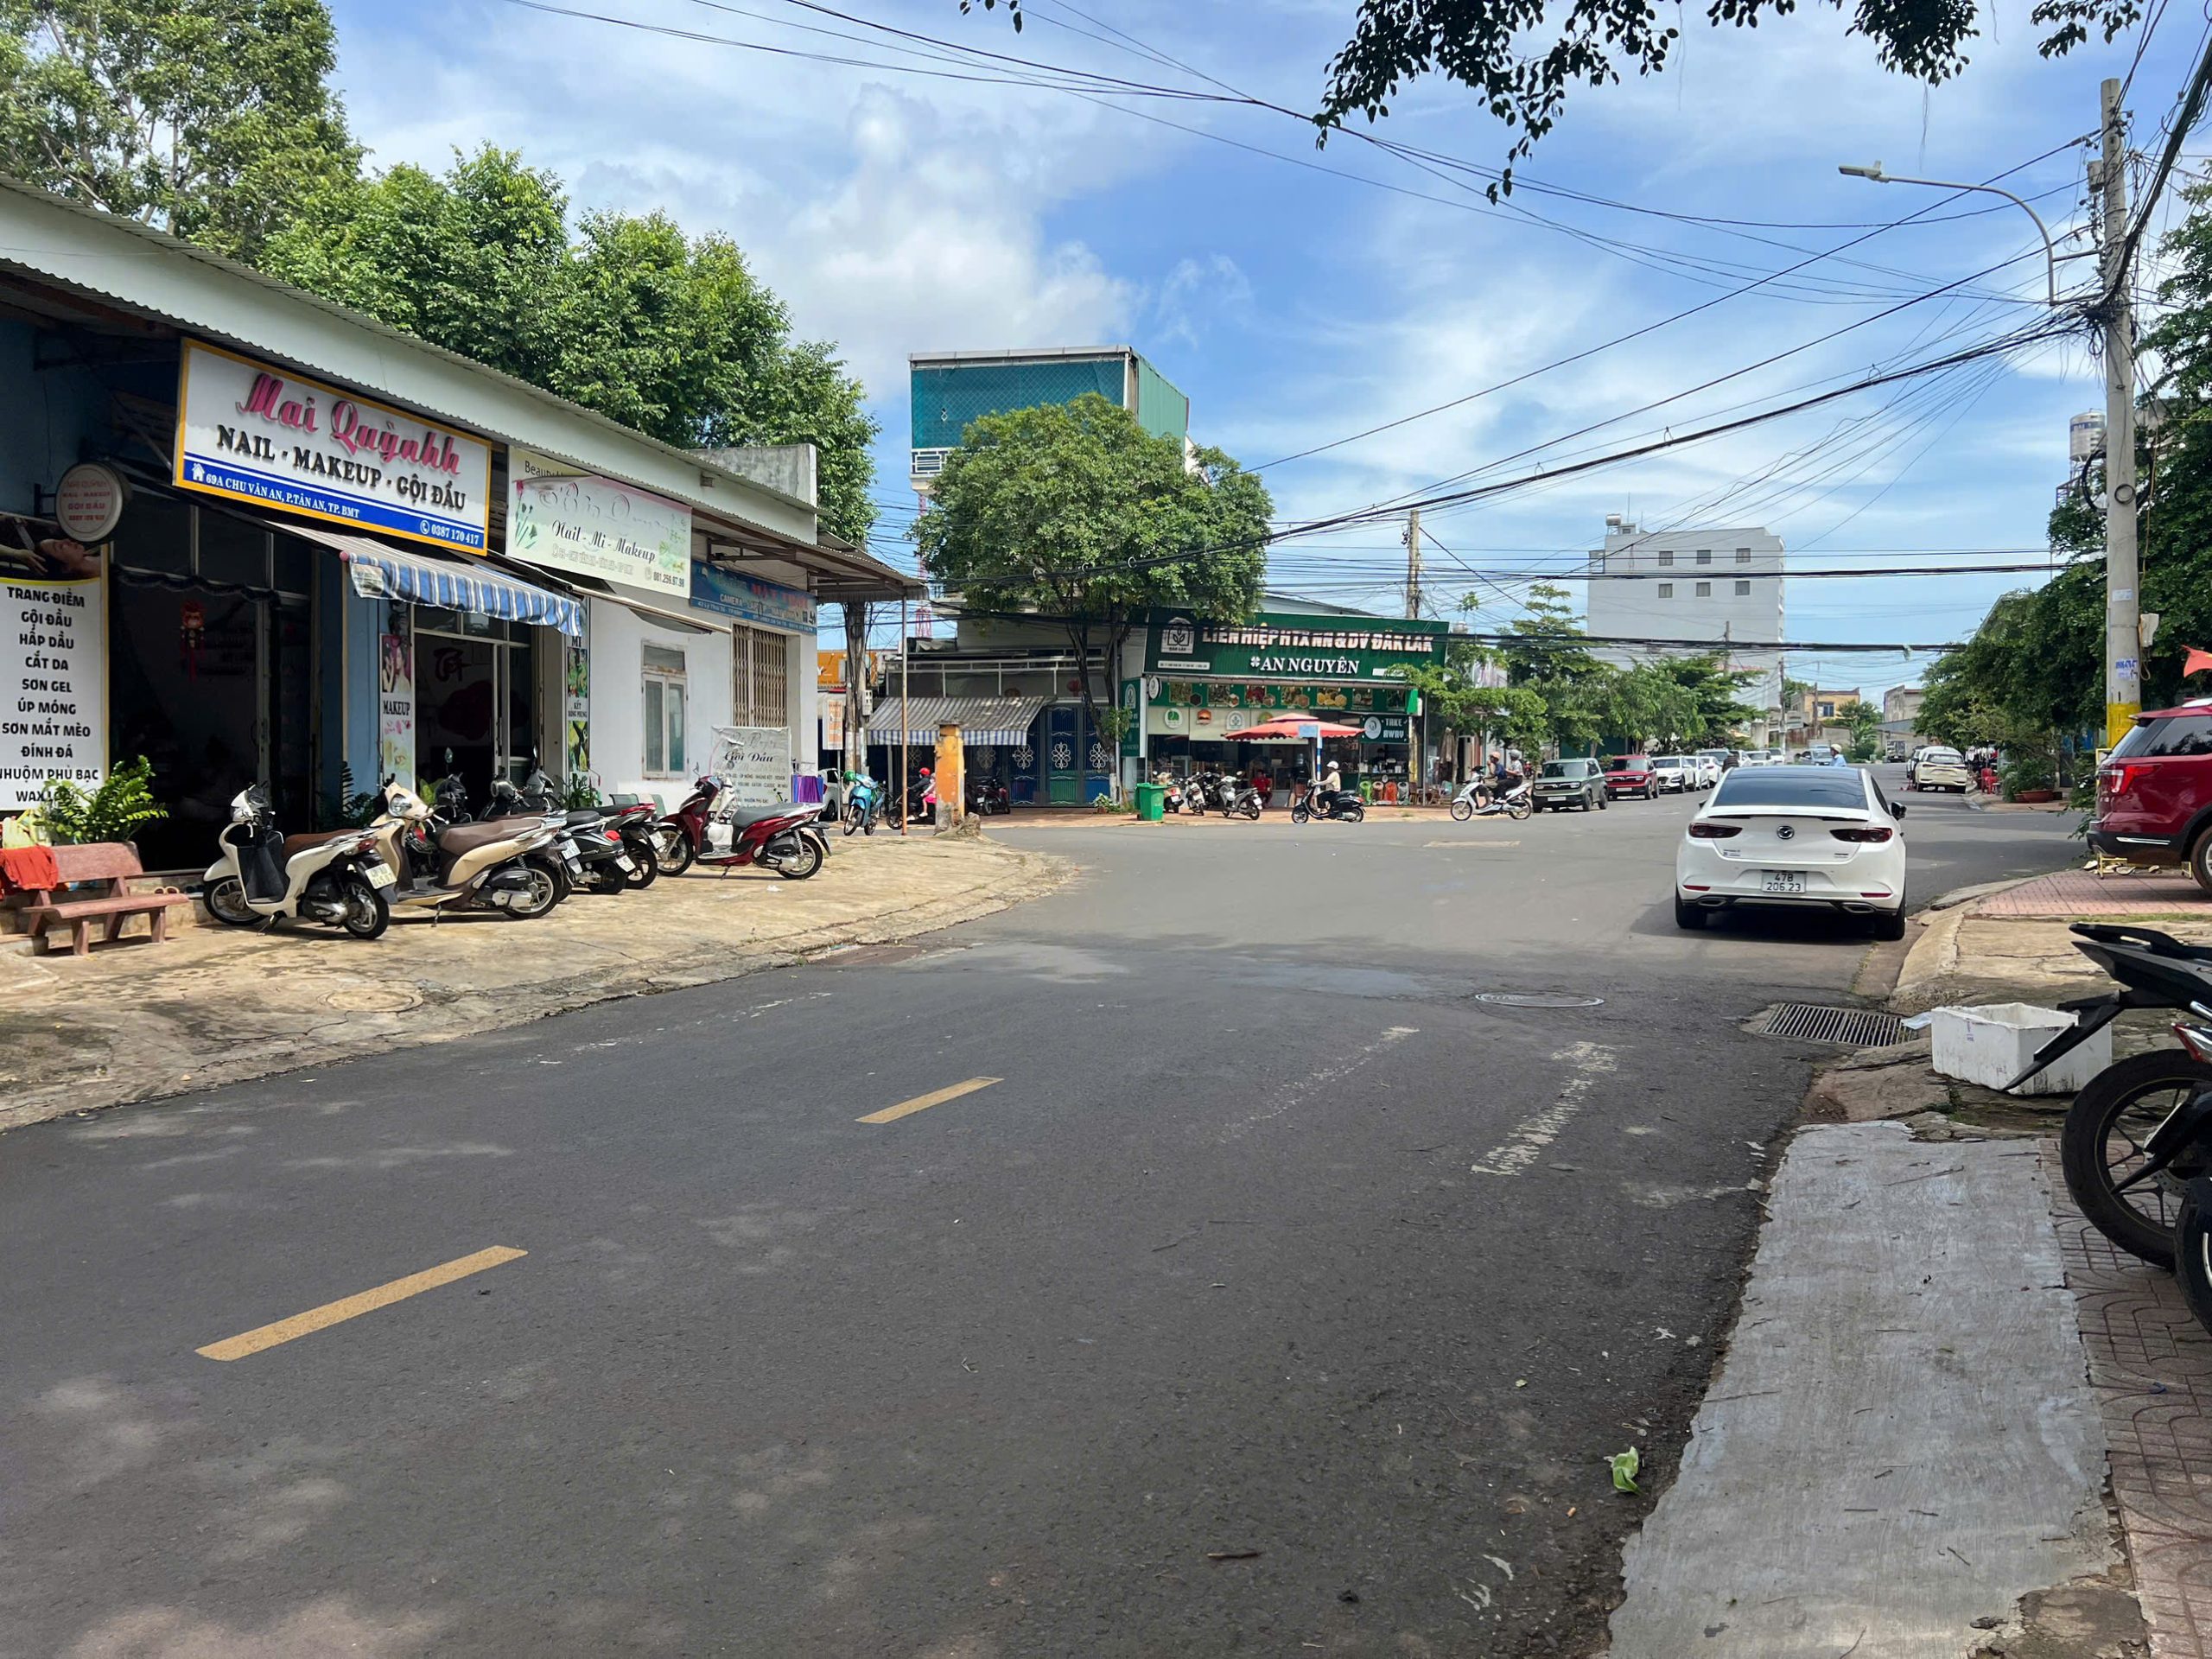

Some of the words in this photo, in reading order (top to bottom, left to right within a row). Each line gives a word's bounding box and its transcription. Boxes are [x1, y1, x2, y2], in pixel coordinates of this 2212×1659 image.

[235, 372, 319, 433] Mai
[330, 400, 461, 475] Quỳnh
[218, 424, 276, 461] NAIL
[293, 446, 382, 488] MAKEUP
[397, 474, 428, 505] GỘI
[432, 480, 467, 511] ĐẦU
[206, 474, 224, 486] 69A
[225, 477, 247, 493] CHU
[248, 482, 268, 498] VĂN
[341, 505, 360, 518] BMT
[431, 524, 450, 537] 0387
[451, 527, 465, 542] 170
[466, 531, 480, 545] 417
[552, 518, 582, 543] Nail
[588, 530, 607, 549] Mi
[613, 537, 656, 564] Makeup
[7, 586, 50, 603] TRANG
[51, 588, 86, 607] ĐIỂM
[719, 593, 743, 607] CAMERA
[21, 608, 43, 627] GỘI
[45, 607, 73, 627] ĐẦU
[19, 627, 46, 646] HẤP
[1334, 632, 1347, 649] &
[25, 650, 49, 669] CẮT
[52, 658, 69, 671] DA
[1260, 657, 1285, 672] AN
[1287, 655, 1360, 675] NGUYÊN
[22, 677, 48, 692] SƠN
[50, 680, 73, 693] GEL
[17, 696, 35, 713] ÚP
[38, 698, 77, 715] MÓNG
[383, 700, 411, 716] MAKEUP
[31, 716, 60, 736] MẮT
[63, 721, 92, 738] MÈO
[21, 742, 54, 758] ĐÍNH
[54, 743, 73, 759] ĐÁ
[0, 765, 43, 783] HUỘM
[76, 769, 99, 783] BẠC
[16, 790, 45, 802] WAX
[1774, 873, 1795, 882] 47B
